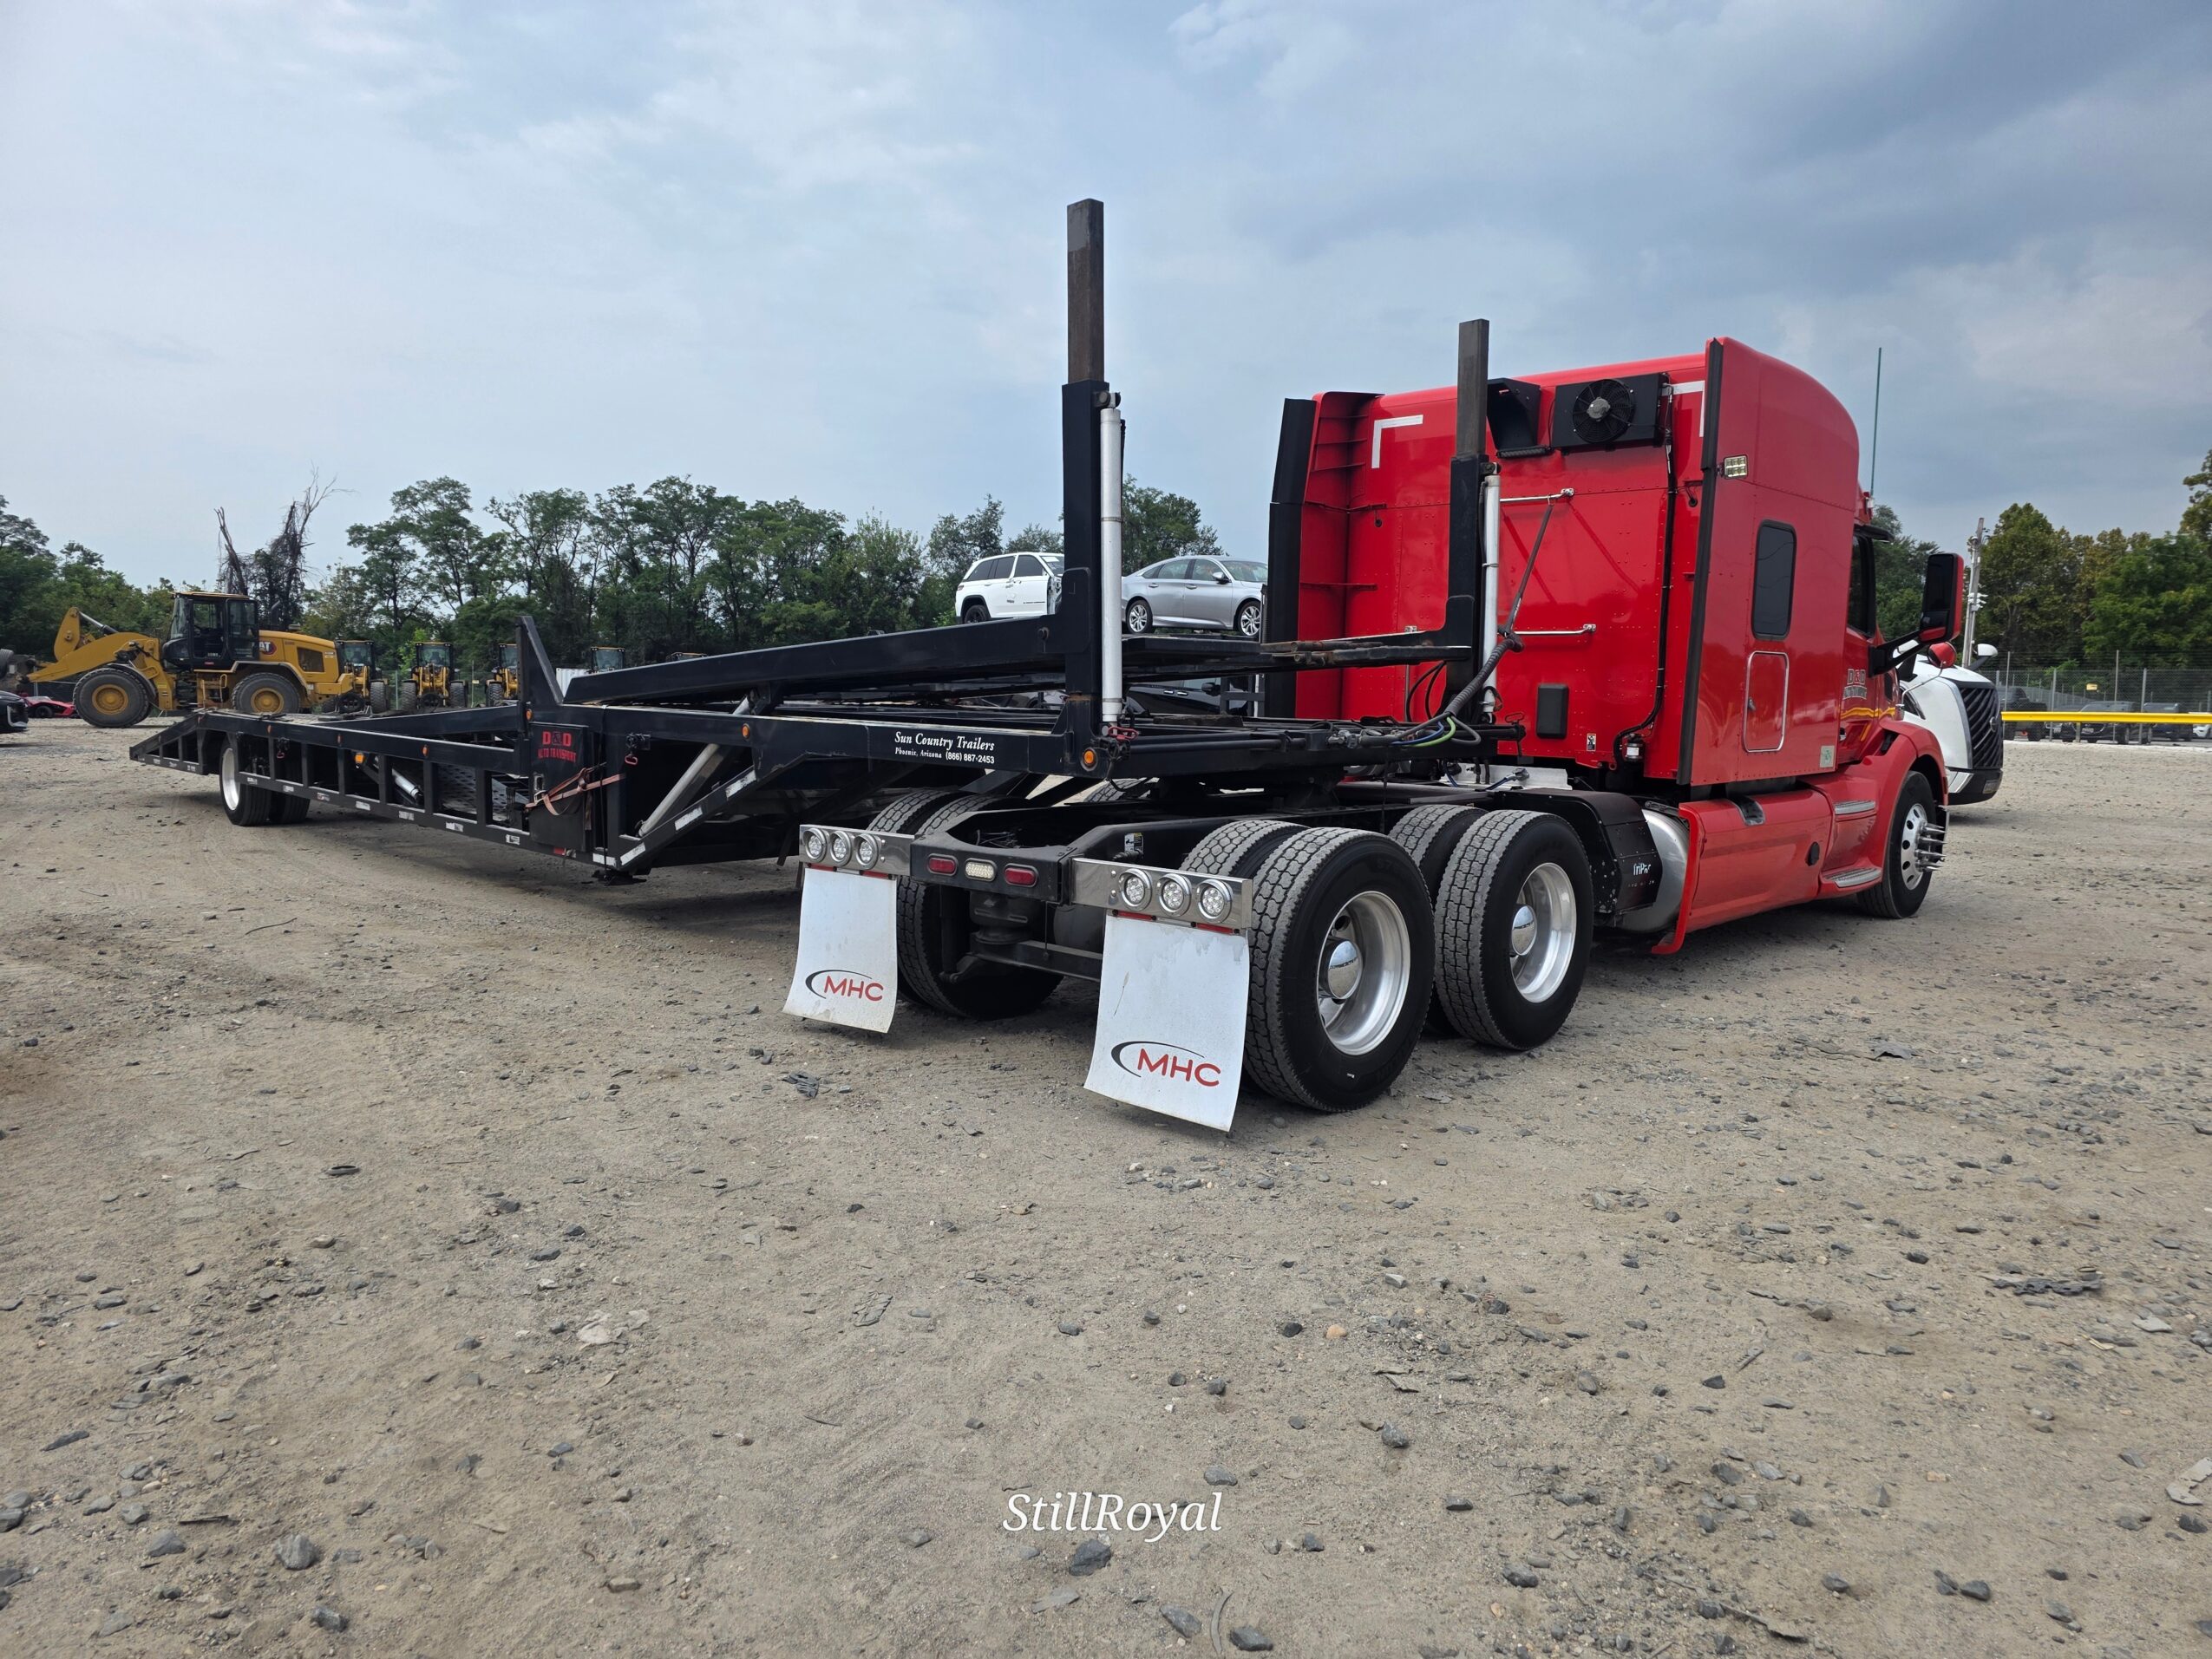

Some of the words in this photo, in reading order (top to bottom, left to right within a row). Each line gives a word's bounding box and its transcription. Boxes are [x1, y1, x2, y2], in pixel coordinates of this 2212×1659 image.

[894, 731, 913, 744] Sun
[915, 733, 953, 751] Country
[957, 735, 995, 751] Trailers
[894, 747, 919, 757] Phoenix,
[919, 749, 942, 759] Arizona
[946, 751, 962, 761] (866)
[823, 975, 884, 1002] MHC
[1137, 1048, 1221, 1087] MHC
